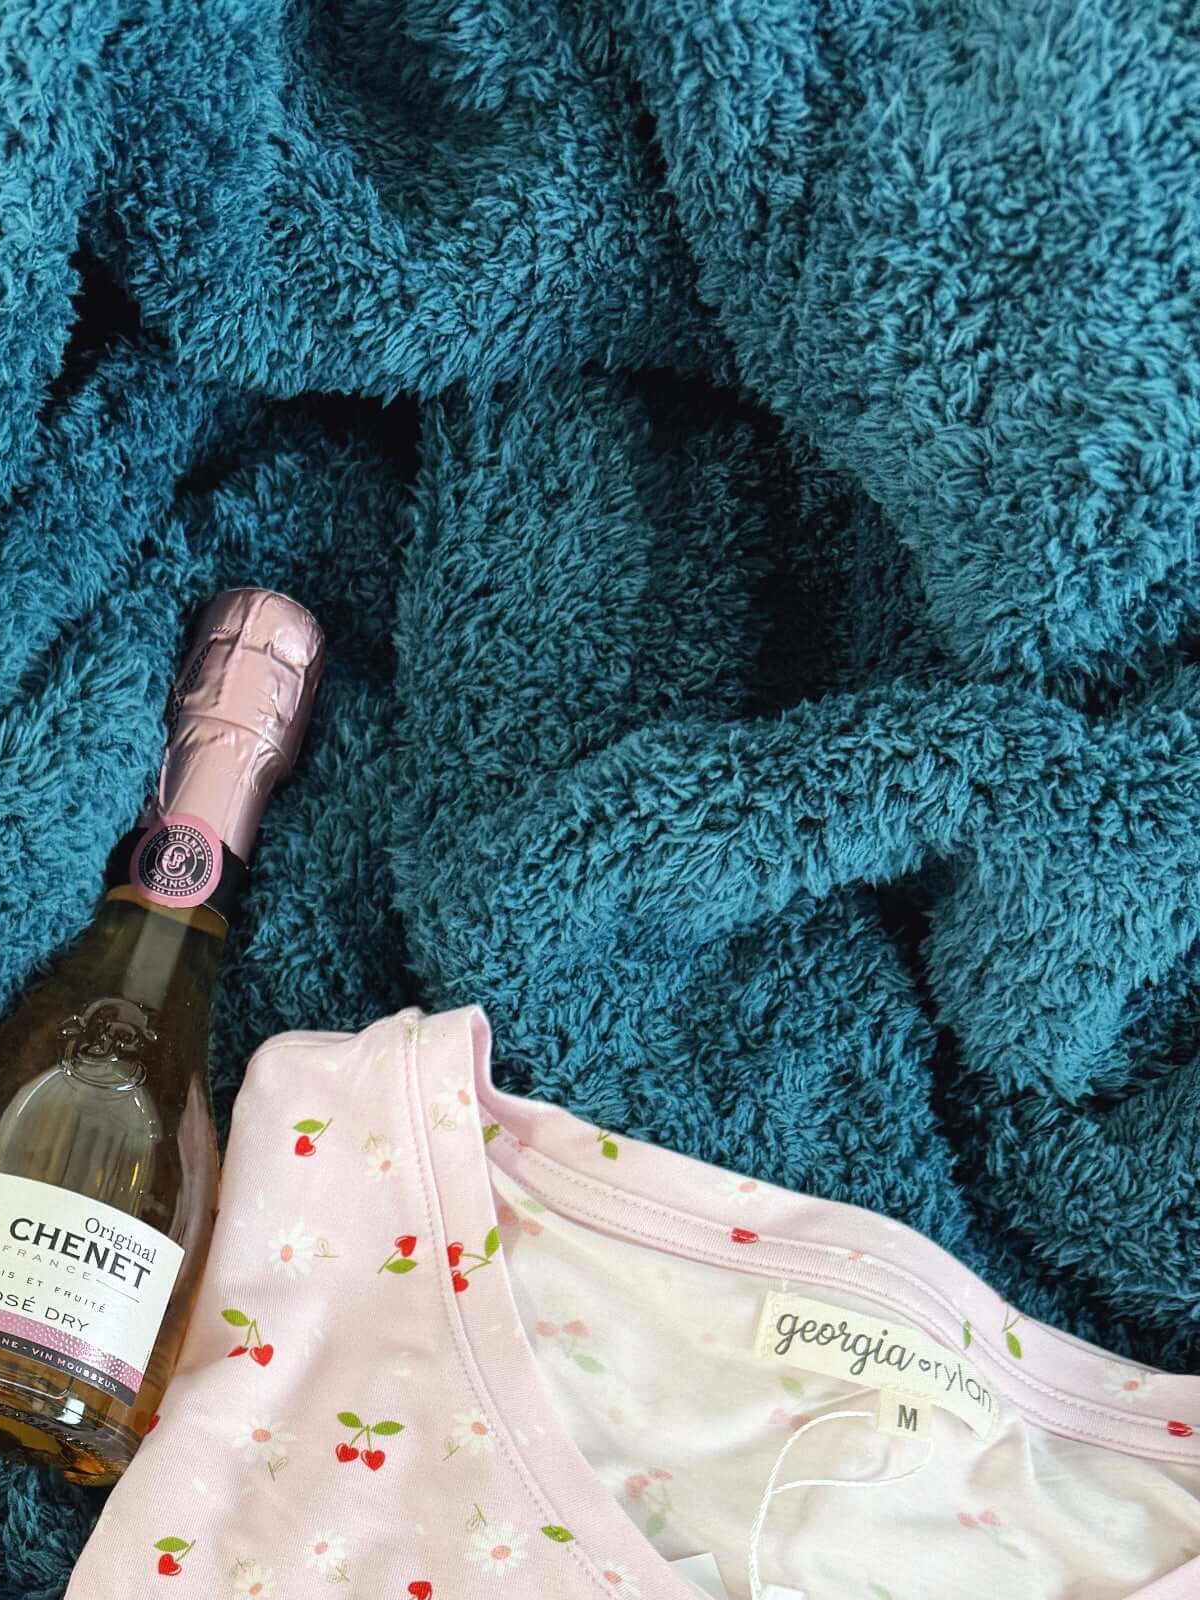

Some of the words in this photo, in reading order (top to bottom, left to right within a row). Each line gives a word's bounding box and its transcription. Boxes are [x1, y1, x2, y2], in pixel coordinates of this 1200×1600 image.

[168, 832, 205, 861] CHENET
[148, 868, 195, 889] FRANCE
[9, 1217, 152, 1289] CHENET
[84, 1217, 158, 1265] Original
[2, 1244, 91, 1281] FRANCE
[26, 1277, 44, 1288] ET
[54, 1286, 107, 1314] FRUITÉ
[45, 1306, 91, 1333] DRY
[32, 1347, 54, 1362] VIN
[57, 1357, 119, 1393] MOUSSEUX
[773, 1312, 916, 1377] georgia
[933, 1359, 993, 1413] rylan
[897, 1404, 919, 1432] M
